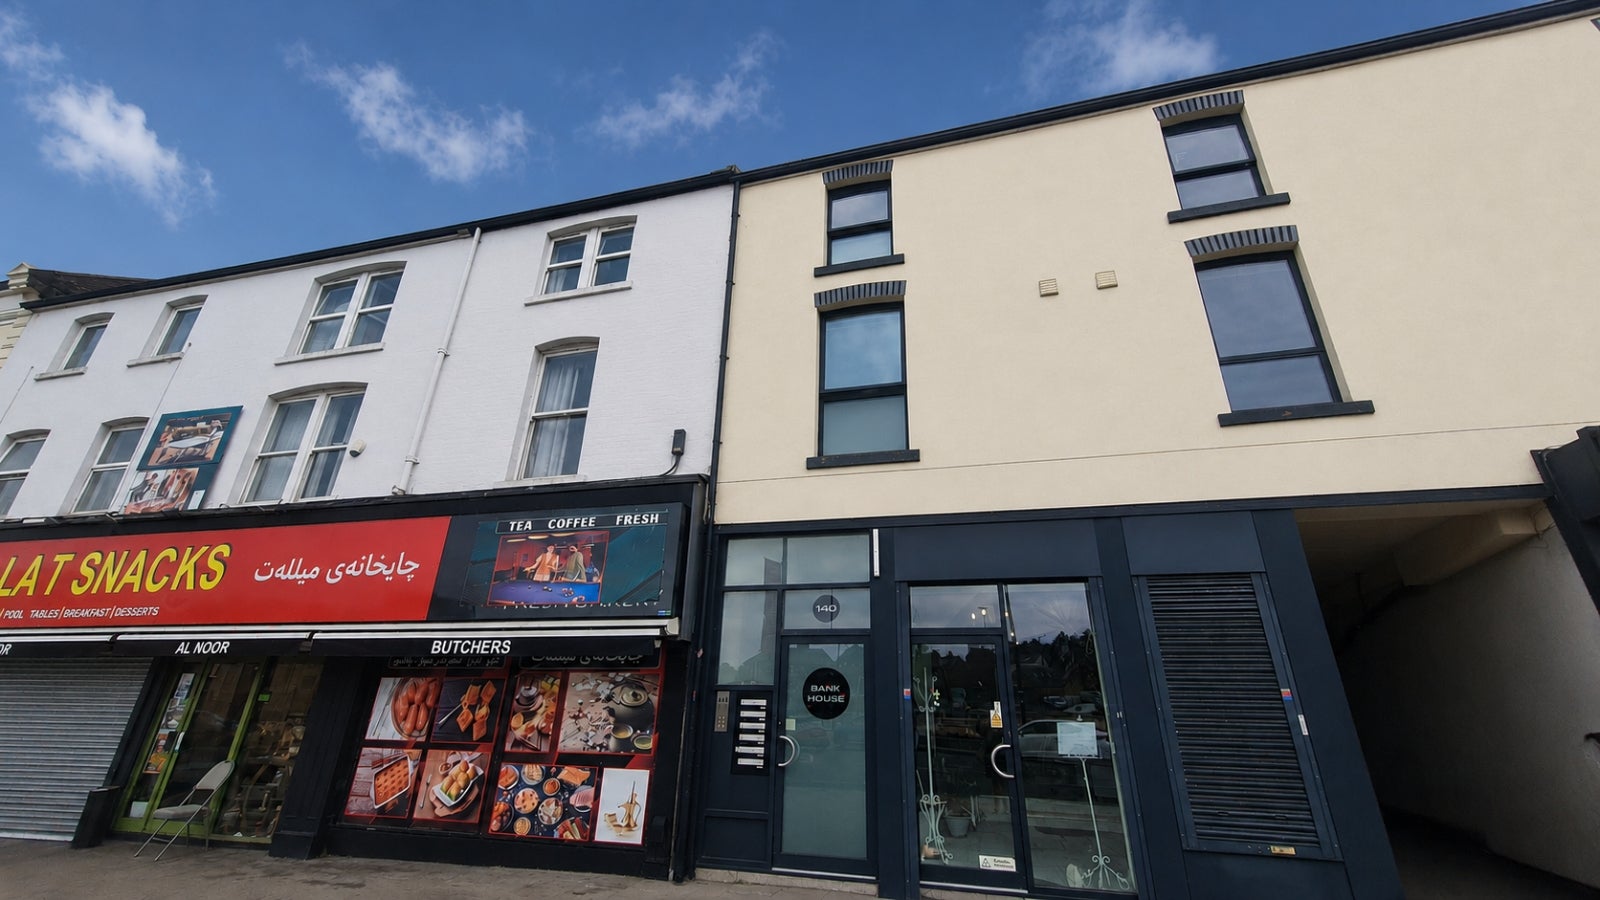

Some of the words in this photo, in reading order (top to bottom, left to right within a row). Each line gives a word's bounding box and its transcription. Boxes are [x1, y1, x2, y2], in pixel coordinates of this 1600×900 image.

[509, 521, 533, 532] TEA
[547, 516, 597, 530] COFFEE
[615, 513, 660, 526] FRESH
[70, 543, 231, 596] SNACKS
[815, 604, 838, 613] 140
[174, 641, 190, 655] AL
[192, 641, 231, 655] NOOR
[430, 640, 512, 655] BUTCHERS
[810, 684, 841, 692] BANK
[807, 694, 846, 703] HOUSE
